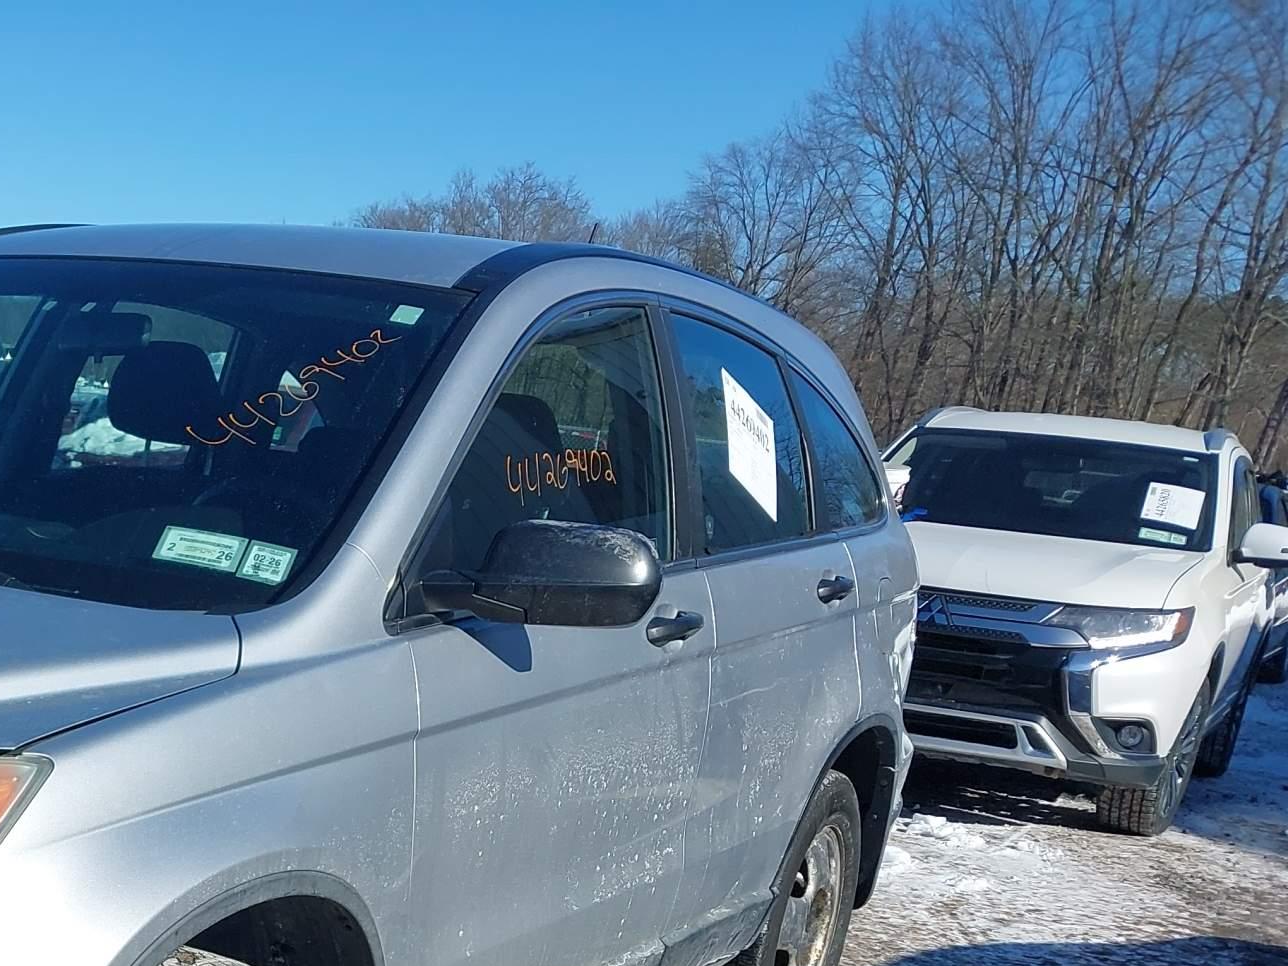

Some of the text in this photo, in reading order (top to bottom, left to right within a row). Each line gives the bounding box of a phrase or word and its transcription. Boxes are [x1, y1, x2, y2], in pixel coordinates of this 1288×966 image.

[186, 330, 403, 445] 44269402
[507, 449, 616, 506] 44269402
[167, 542, 177, 551] 2
[216, 551, 233, 561] 26
